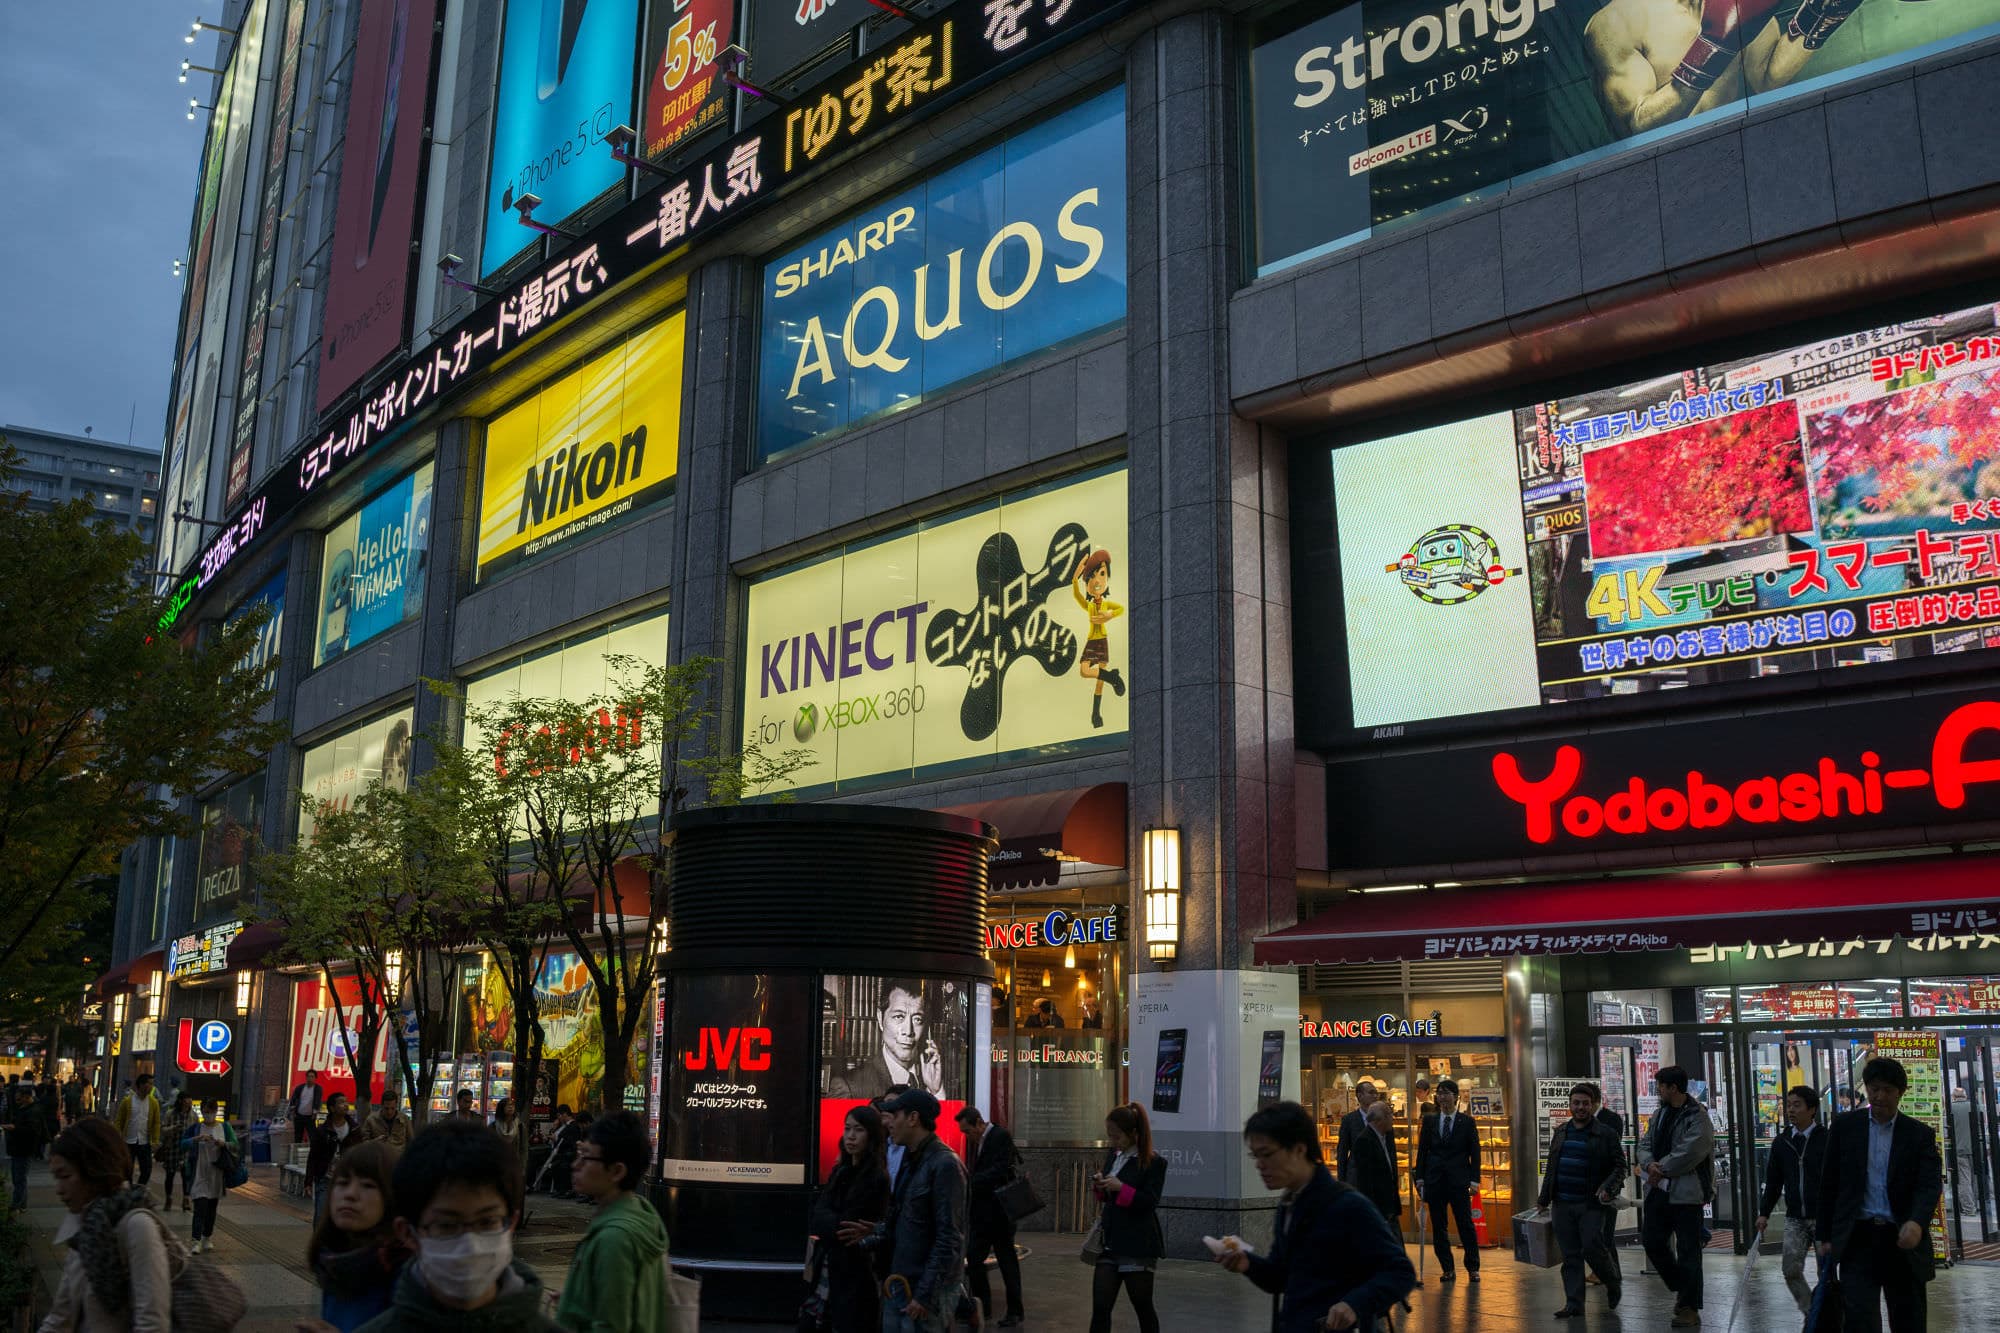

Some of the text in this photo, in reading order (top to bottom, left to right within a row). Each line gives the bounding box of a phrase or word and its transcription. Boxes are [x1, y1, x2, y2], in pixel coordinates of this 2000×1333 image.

[664, 12, 717, 91] 5%
[1294, 0, 1556, 108] Strong
[1298, 40, 1551, 148] すべては強いLTEのために。
[626, 136, 762, 248] 一番人気
[784, 20, 952, 172] 「ゆず茶」
[1352, 129, 1433, 171] docomo LTE
[518, 140, 573, 195] iPhone
[774, 206, 916, 298] SHARP
[786, 187, 1105, 400] AQUOS
[517, 424, 647, 535] Nikon
[357, 510, 410, 575] Hello!
[524, 496, 633, 556] http://www.nikon-image.com/
[1544, 508, 1583, 530] QUOS
[353, 554, 405, 612] WiMAX
[761, 601, 929, 699] KINECT
[1580, 609, 1857, 673] 世界中のお客様が注目の
[758, 685, 925, 745] for XBOX 360
[203, 864, 241, 903] REGZA
[1628, 932, 1668, 946] Akiba
[1138, 1003, 1169, 1014] XPERIA
[1243, 1002, 1274, 1014] XPERIA
[1298, 1014, 1373, 1039] RANCE
[1793, 999, 1836, 1010] 年中無休
[195, 1061, 221, 1072] 入口
[685, 1027, 772, 1071] JVC
[686, 1097, 769, 1109] グローバルブランドです。
